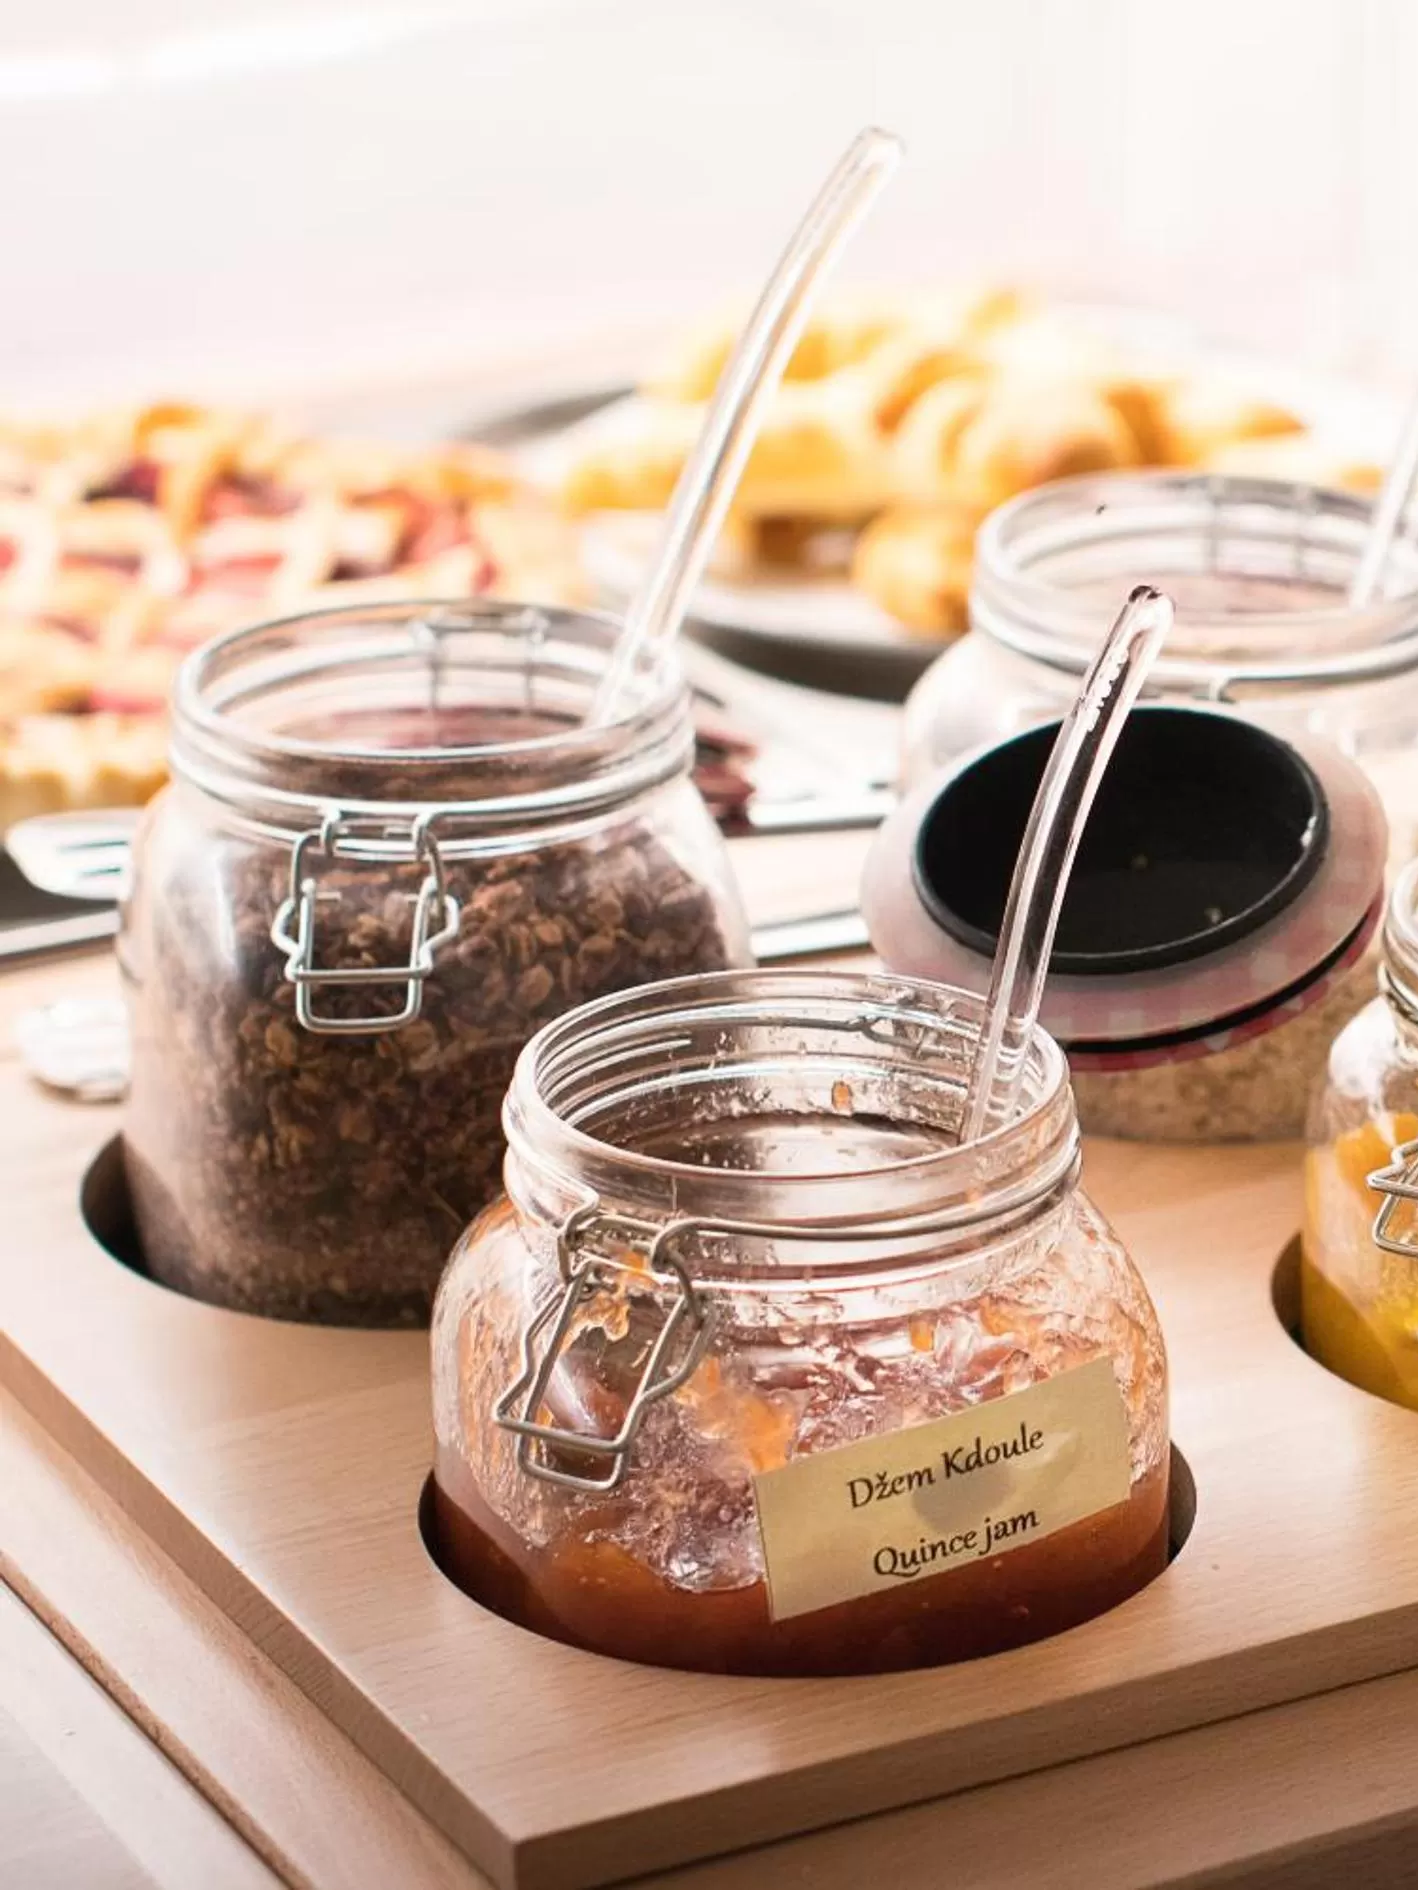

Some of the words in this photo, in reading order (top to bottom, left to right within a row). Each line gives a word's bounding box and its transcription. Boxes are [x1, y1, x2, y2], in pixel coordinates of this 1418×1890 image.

[846, 1467, 934, 1509] Džem
[941, 1421, 1045, 1480] Kdoule
[873, 1530, 977, 1578] Quince
[978, 1508, 1040, 1556] jam
